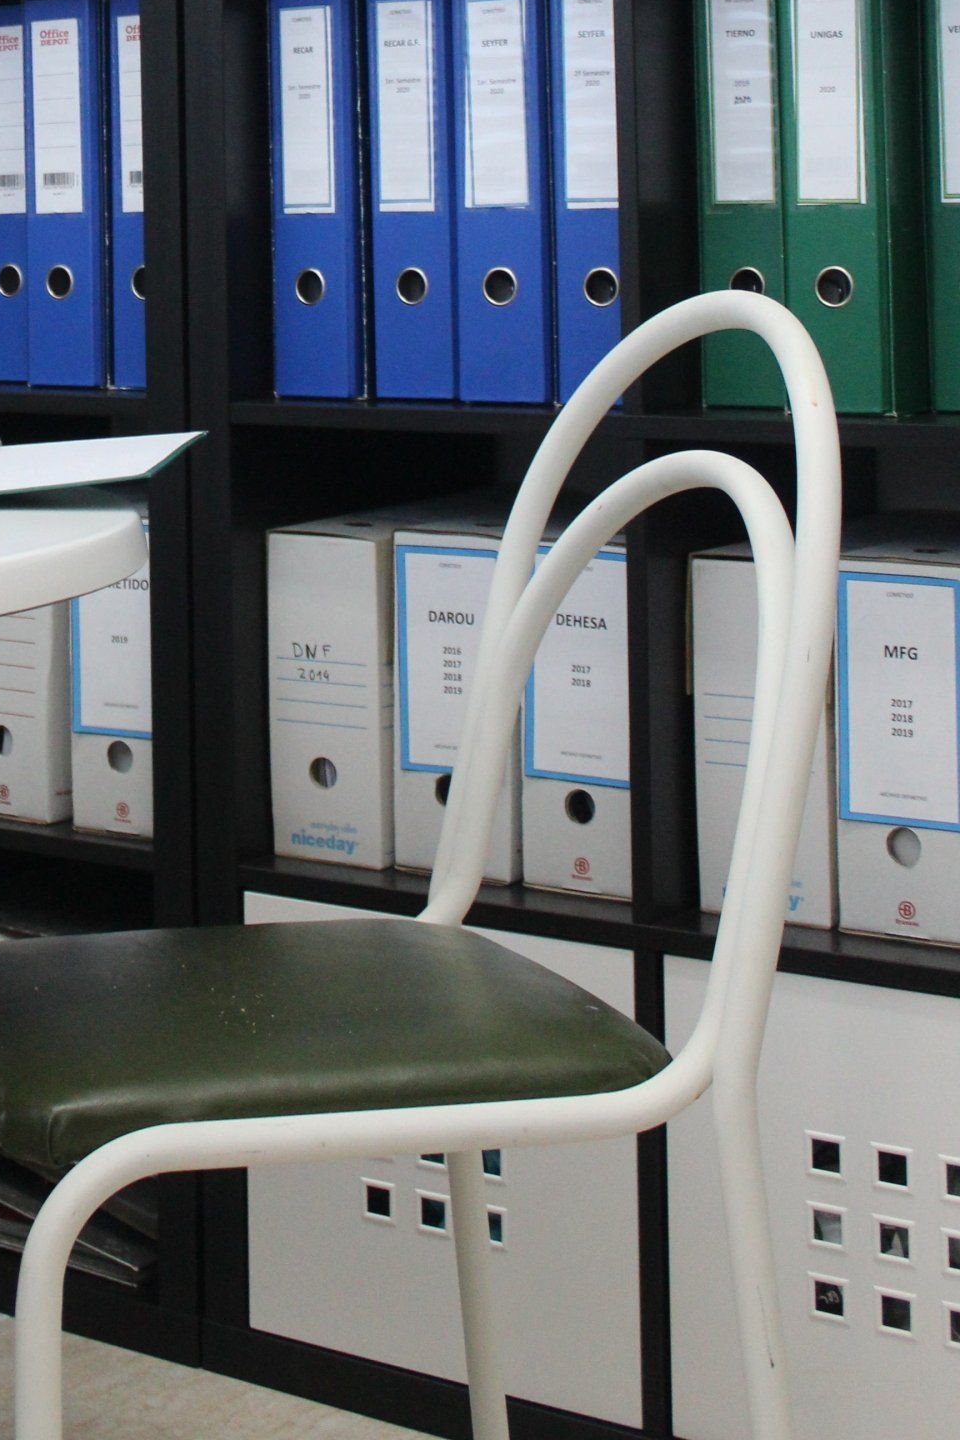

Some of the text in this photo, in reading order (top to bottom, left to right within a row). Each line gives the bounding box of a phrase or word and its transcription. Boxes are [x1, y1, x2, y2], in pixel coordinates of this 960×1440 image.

[40, 29, 69, 39] Office
[578, 30, 606, 39] SEYFER
[725, 29, 755, 38] TIERNO
[810, 30, 844, 39] UNIGAS
[40, 38, 69, 46] DEPOT
[383, 39, 405, 48] RECAR
[481, 39, 508, 48] SEYFER
[293, 46, 313, 54] RECAR
[582, 69, 610, 77] Semestre
[108, 578, 149, 591] ETIDO
[429, 610, 475, 626] DAROU
[556, 613, 608, 631] DEHESA
[111, 635, 128, 644] 2019
[442, 646, 462, 656] 2016
[884, 644, 919, 661] MFG
[442, 659, 462, 669] 2017
[571, 664, 591, 674] 2017
[443, 673, 462, 682] 2018
[571, 677, 591, 688] 2018
[443, 686, 463, 695] 2019
[891, 698, 913, 709] 2017
[891, 713, 914, 724] 2018
[891, 727, 914, 738] 2019
[291, 828, 359, 856] niceday
